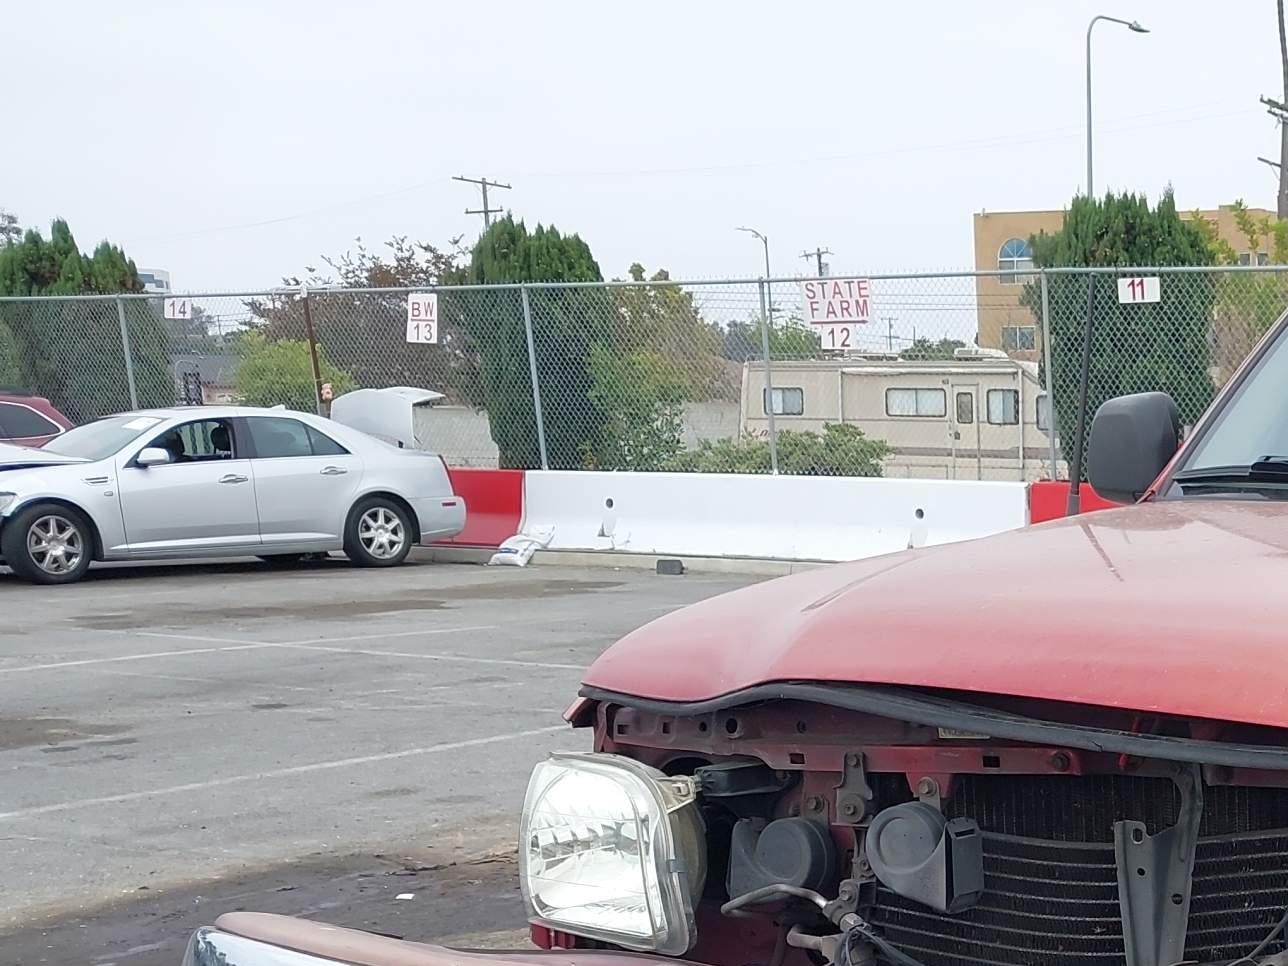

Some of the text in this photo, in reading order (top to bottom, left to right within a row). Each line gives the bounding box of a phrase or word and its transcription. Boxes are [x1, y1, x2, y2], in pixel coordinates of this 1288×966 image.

[805, 280, 870, 300] STATE
[1127, 278, 1146, 301] 11
[169, 300, 188, 318] 14
[411, 301, 435, 318] BW
[809, 299, 869, 319] FARM
[413, 322, 434, 342] 13
[828, 327, 851, 348] 12
